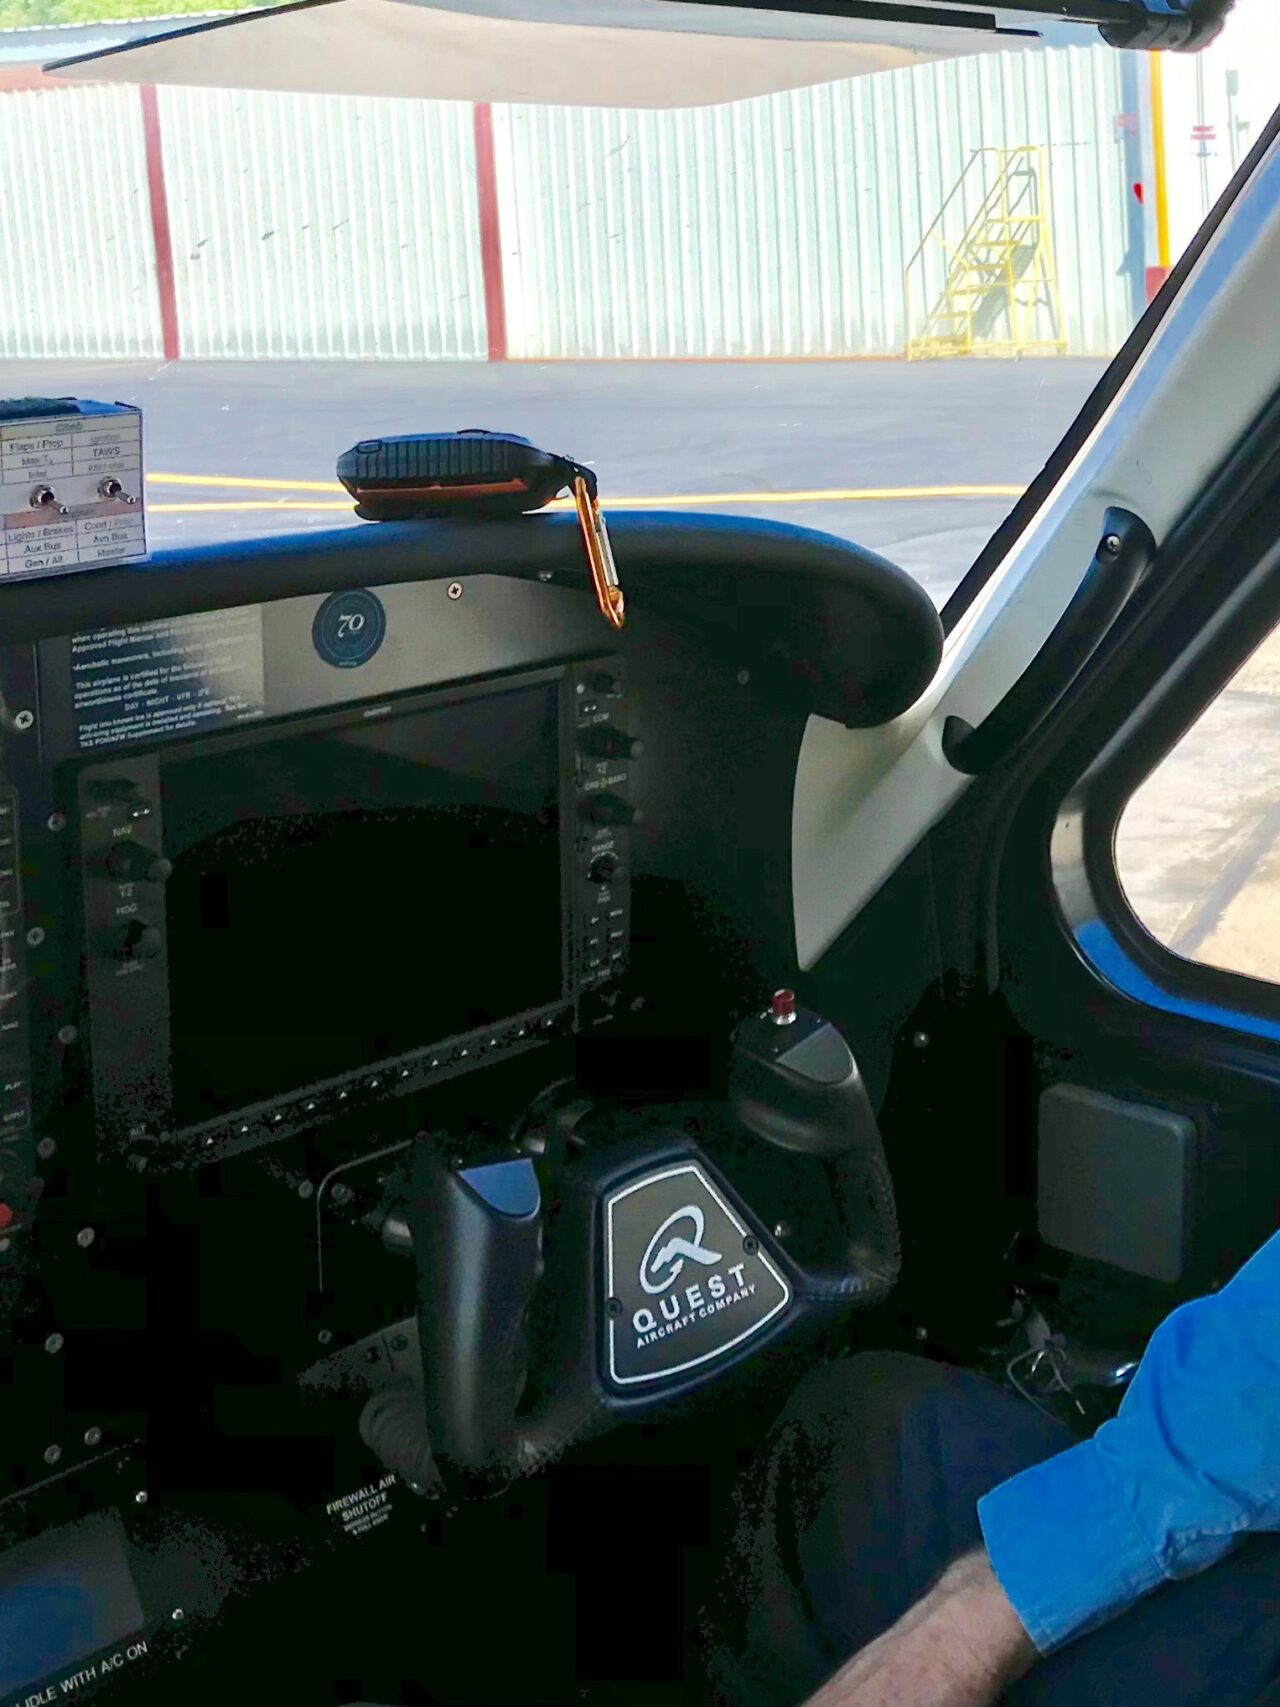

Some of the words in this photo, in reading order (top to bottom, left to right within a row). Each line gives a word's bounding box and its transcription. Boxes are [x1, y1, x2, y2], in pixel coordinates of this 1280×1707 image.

[92, 446, 120, 457] TAWS
[337, 613, 365, 639] 70
[76, 681, 91, 690] This
[92, 675, 120, 687] airplane
[74, 687, 112, 700] operations
[125, 702, 139, 711] DAY
[80, 723, 98, 733] Flight
[113, 824, 133, 838] NAV
[632, 1263, 746, 1334] QUEST
[636, 1312, 697, 1349] AIRCRAFT
[699, 1284, 756, 1318] COMPANY
[326, 1484, 378, 1515] FIREWALL
[379, 1474, 396, 1490] AIR
[342, 1491, 388, 1522] SHUTOFF
[24, 1685, 57, 1707] IDLE
[60, 1666, 97, 1693] WITH
[101, 1653, 124, 1674] A/C
[126, 1640, 148, 1660] ON
